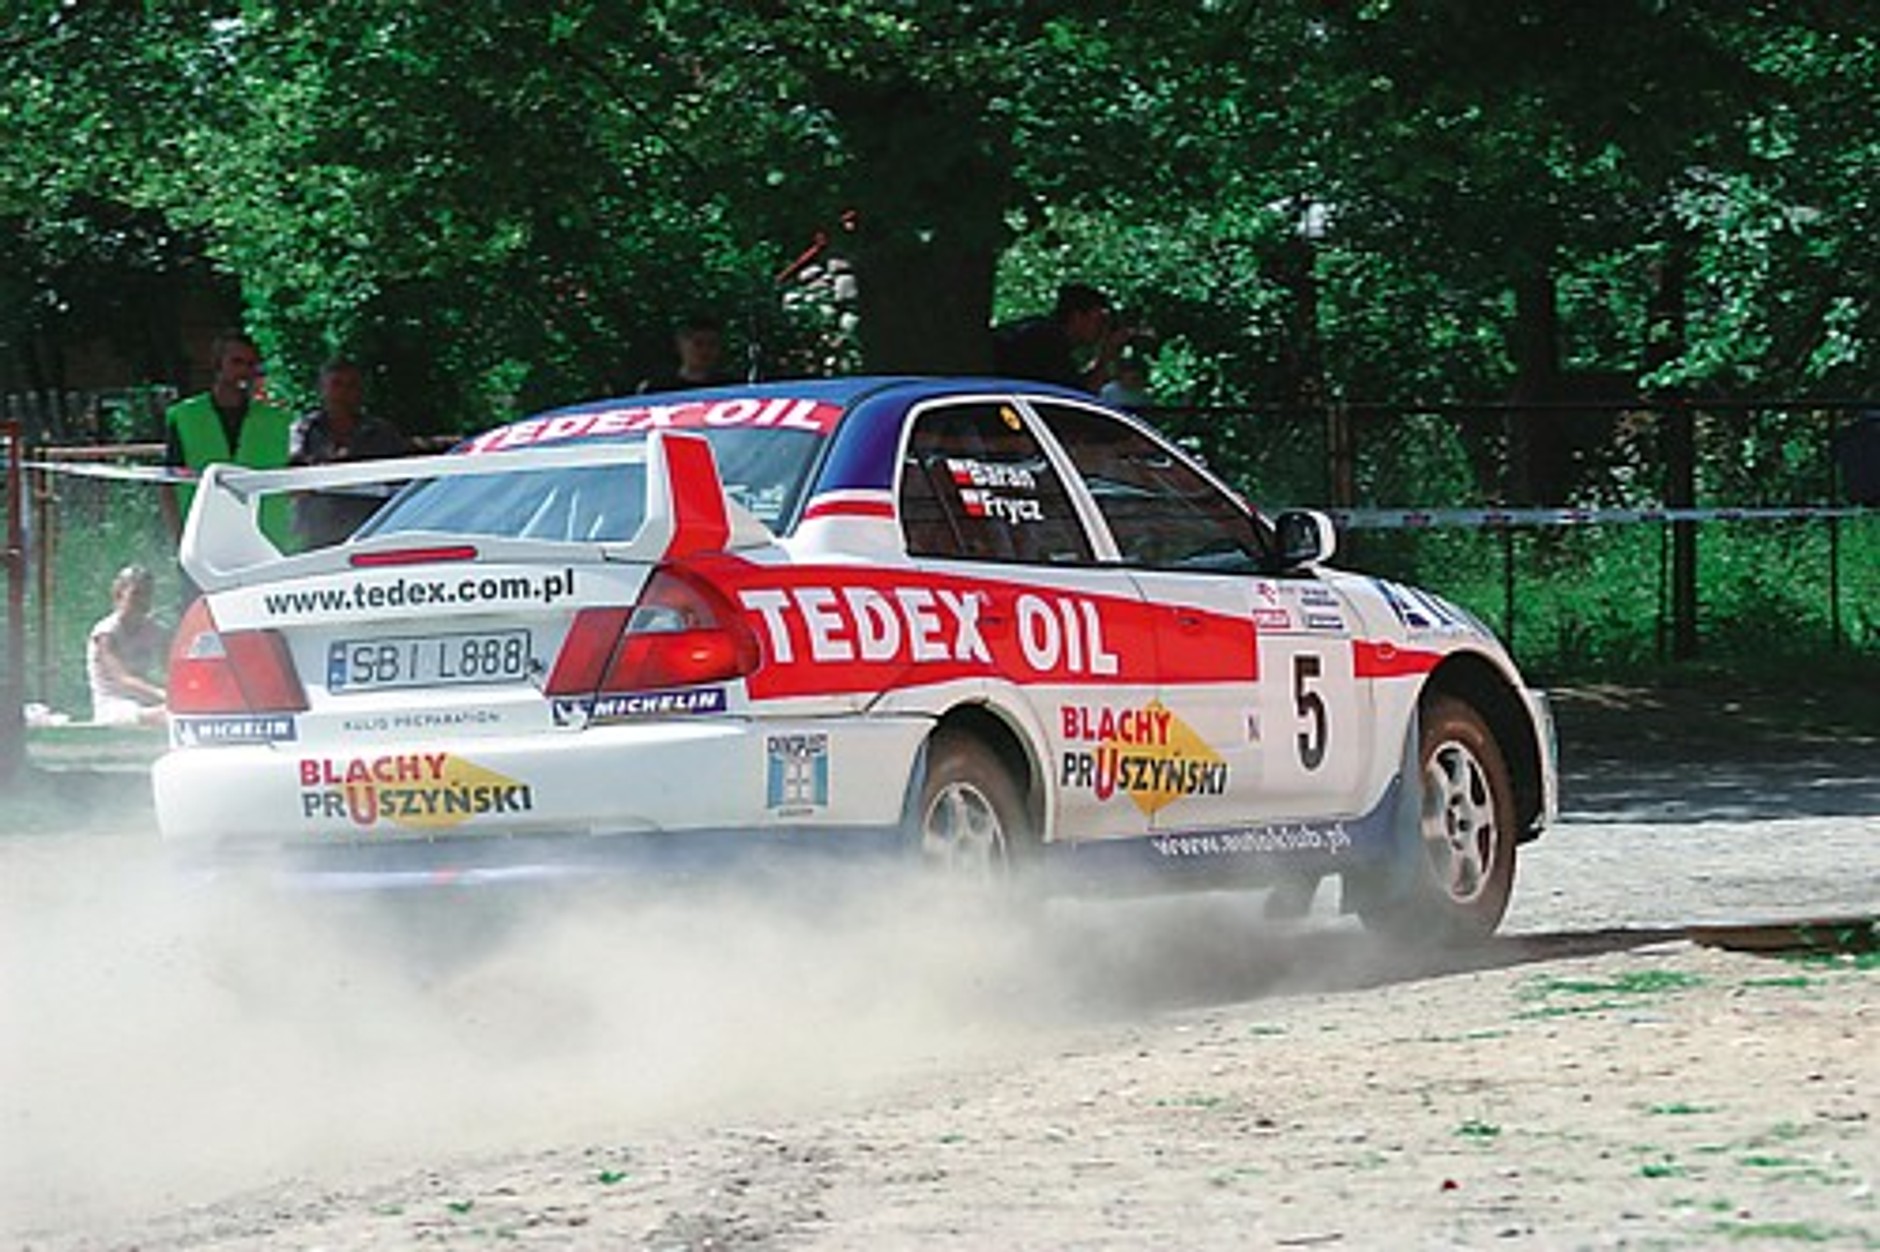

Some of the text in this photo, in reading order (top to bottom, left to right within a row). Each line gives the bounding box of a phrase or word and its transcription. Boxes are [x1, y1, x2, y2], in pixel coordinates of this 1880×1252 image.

[468, 398, 823, 454] TEDEX OIL
[980, 490, 1045, 526] Frycz
[264, 568, 575, 615] www.tedex.com.pl
[738, 586, 1119, 675] TEDEX OIL
[352, 636, 524, 684] SBI L888
[394, 709, 500, 728] PREPARATION
[593, 689, 719, 717] MICHELIN
[1060, 705, 1170, 746] BLACHY
[1293, 653, 1328, 772] 5
[199, 717, 290, 739] MICHELIN
[299, 752, 447, 786] BLACHY
[1060, 746, 1228, 802] PRUSZYŃSKI
[302, 780, 533, 825] PRUSZYŃSKI
